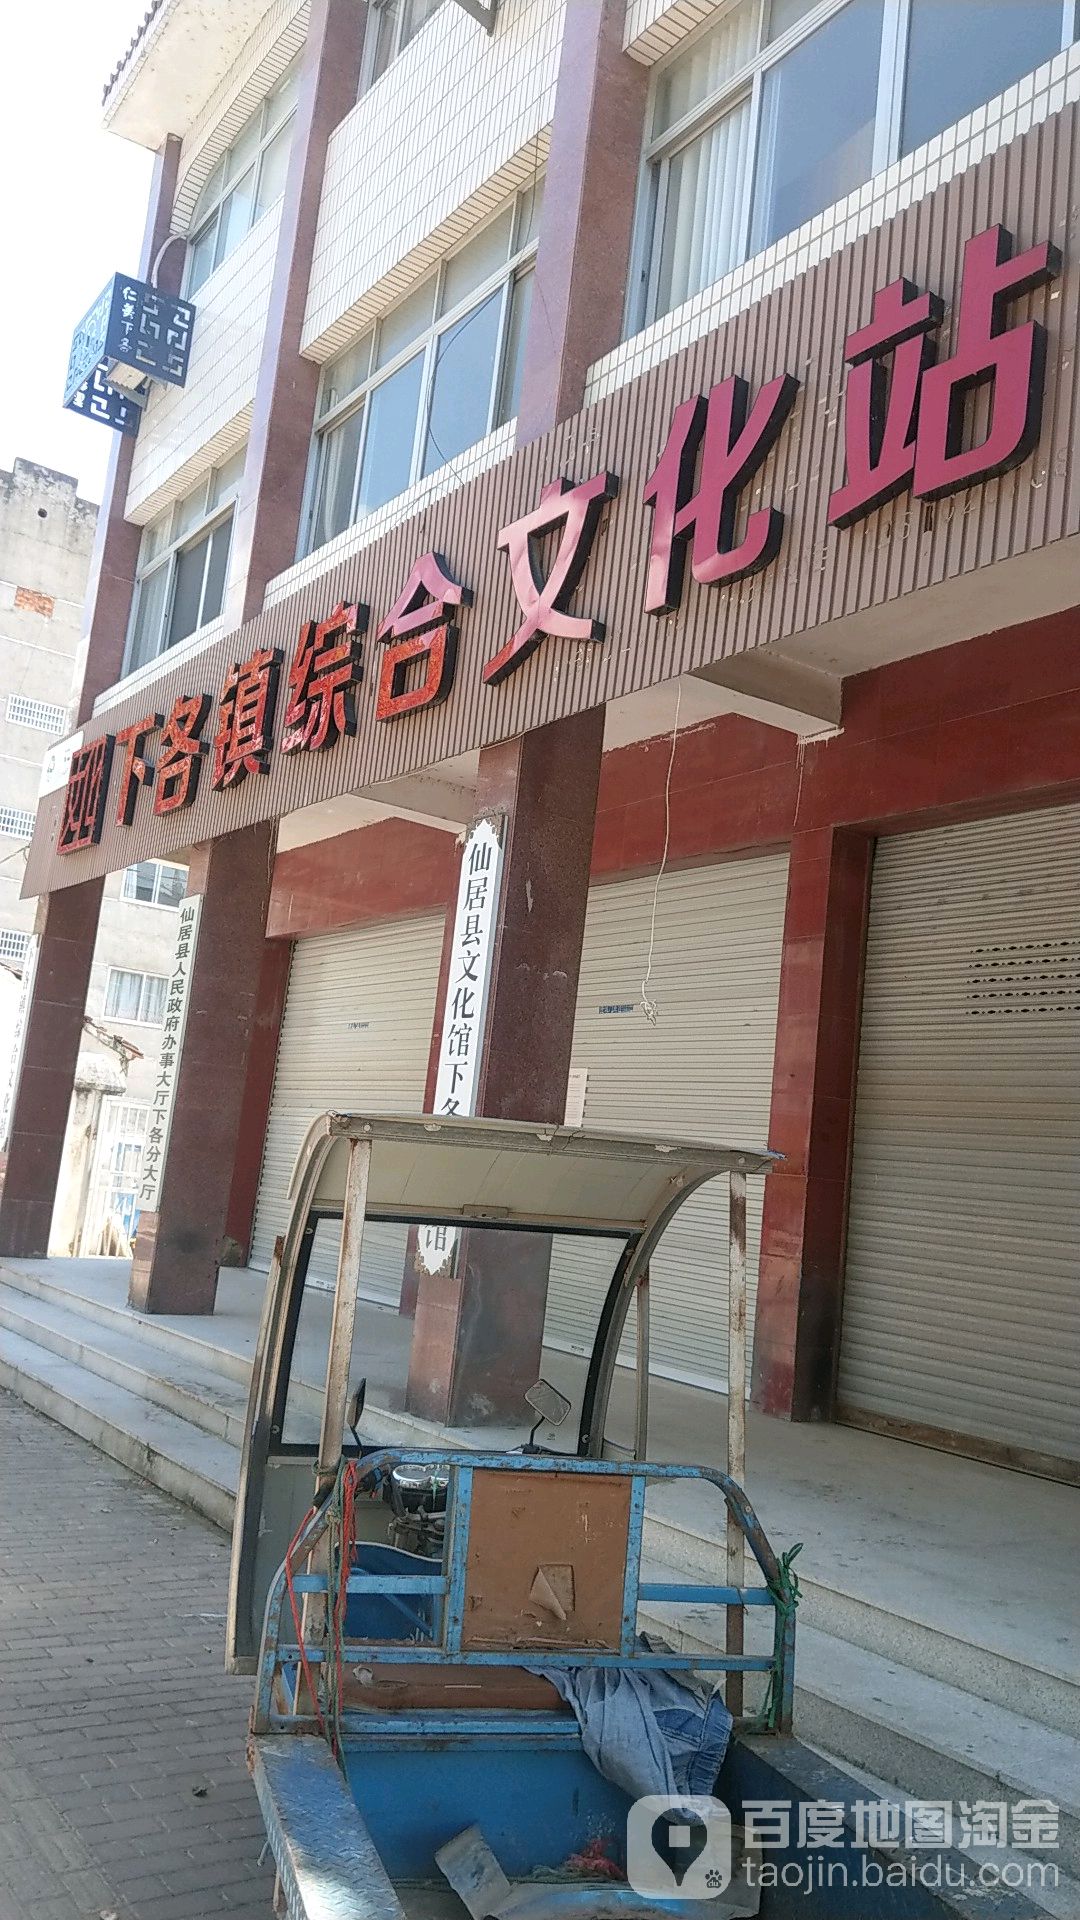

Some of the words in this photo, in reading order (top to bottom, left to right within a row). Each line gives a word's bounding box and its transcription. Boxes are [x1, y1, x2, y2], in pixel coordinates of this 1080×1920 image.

[115, 223, 1061, 828] 下各镇综合文化站
[139, 906, 195, 1200] 仙居县人民政府办事大厅下各分大厅
